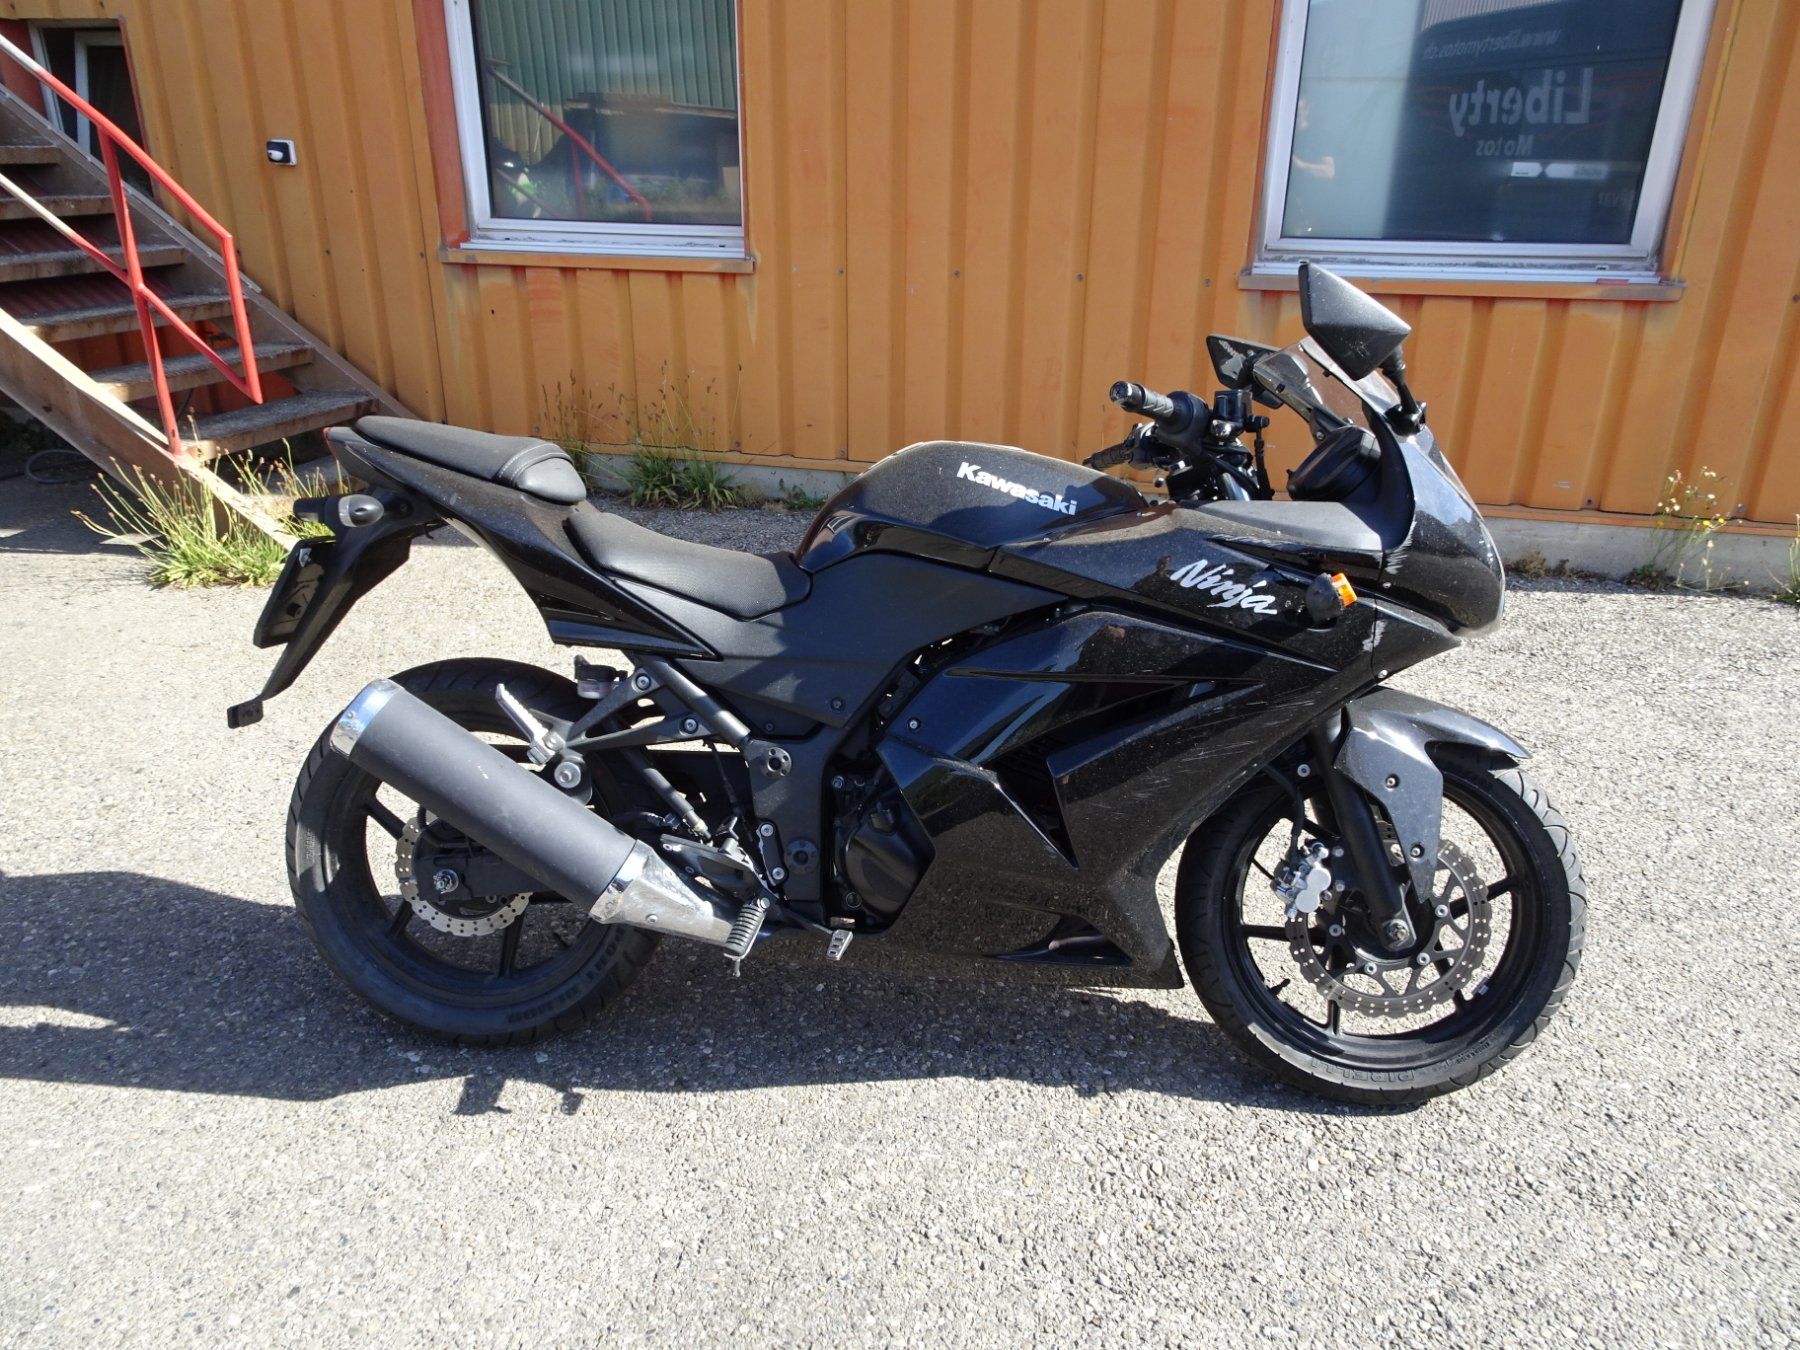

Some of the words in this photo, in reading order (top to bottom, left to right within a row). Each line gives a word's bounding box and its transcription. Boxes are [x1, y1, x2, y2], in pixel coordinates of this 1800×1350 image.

[956, 461, 1078, 516] Kawasaki
[1170, 559, 1278, 615] Ninja
[1311, 1058, 1414, 1083] PIRELLI
